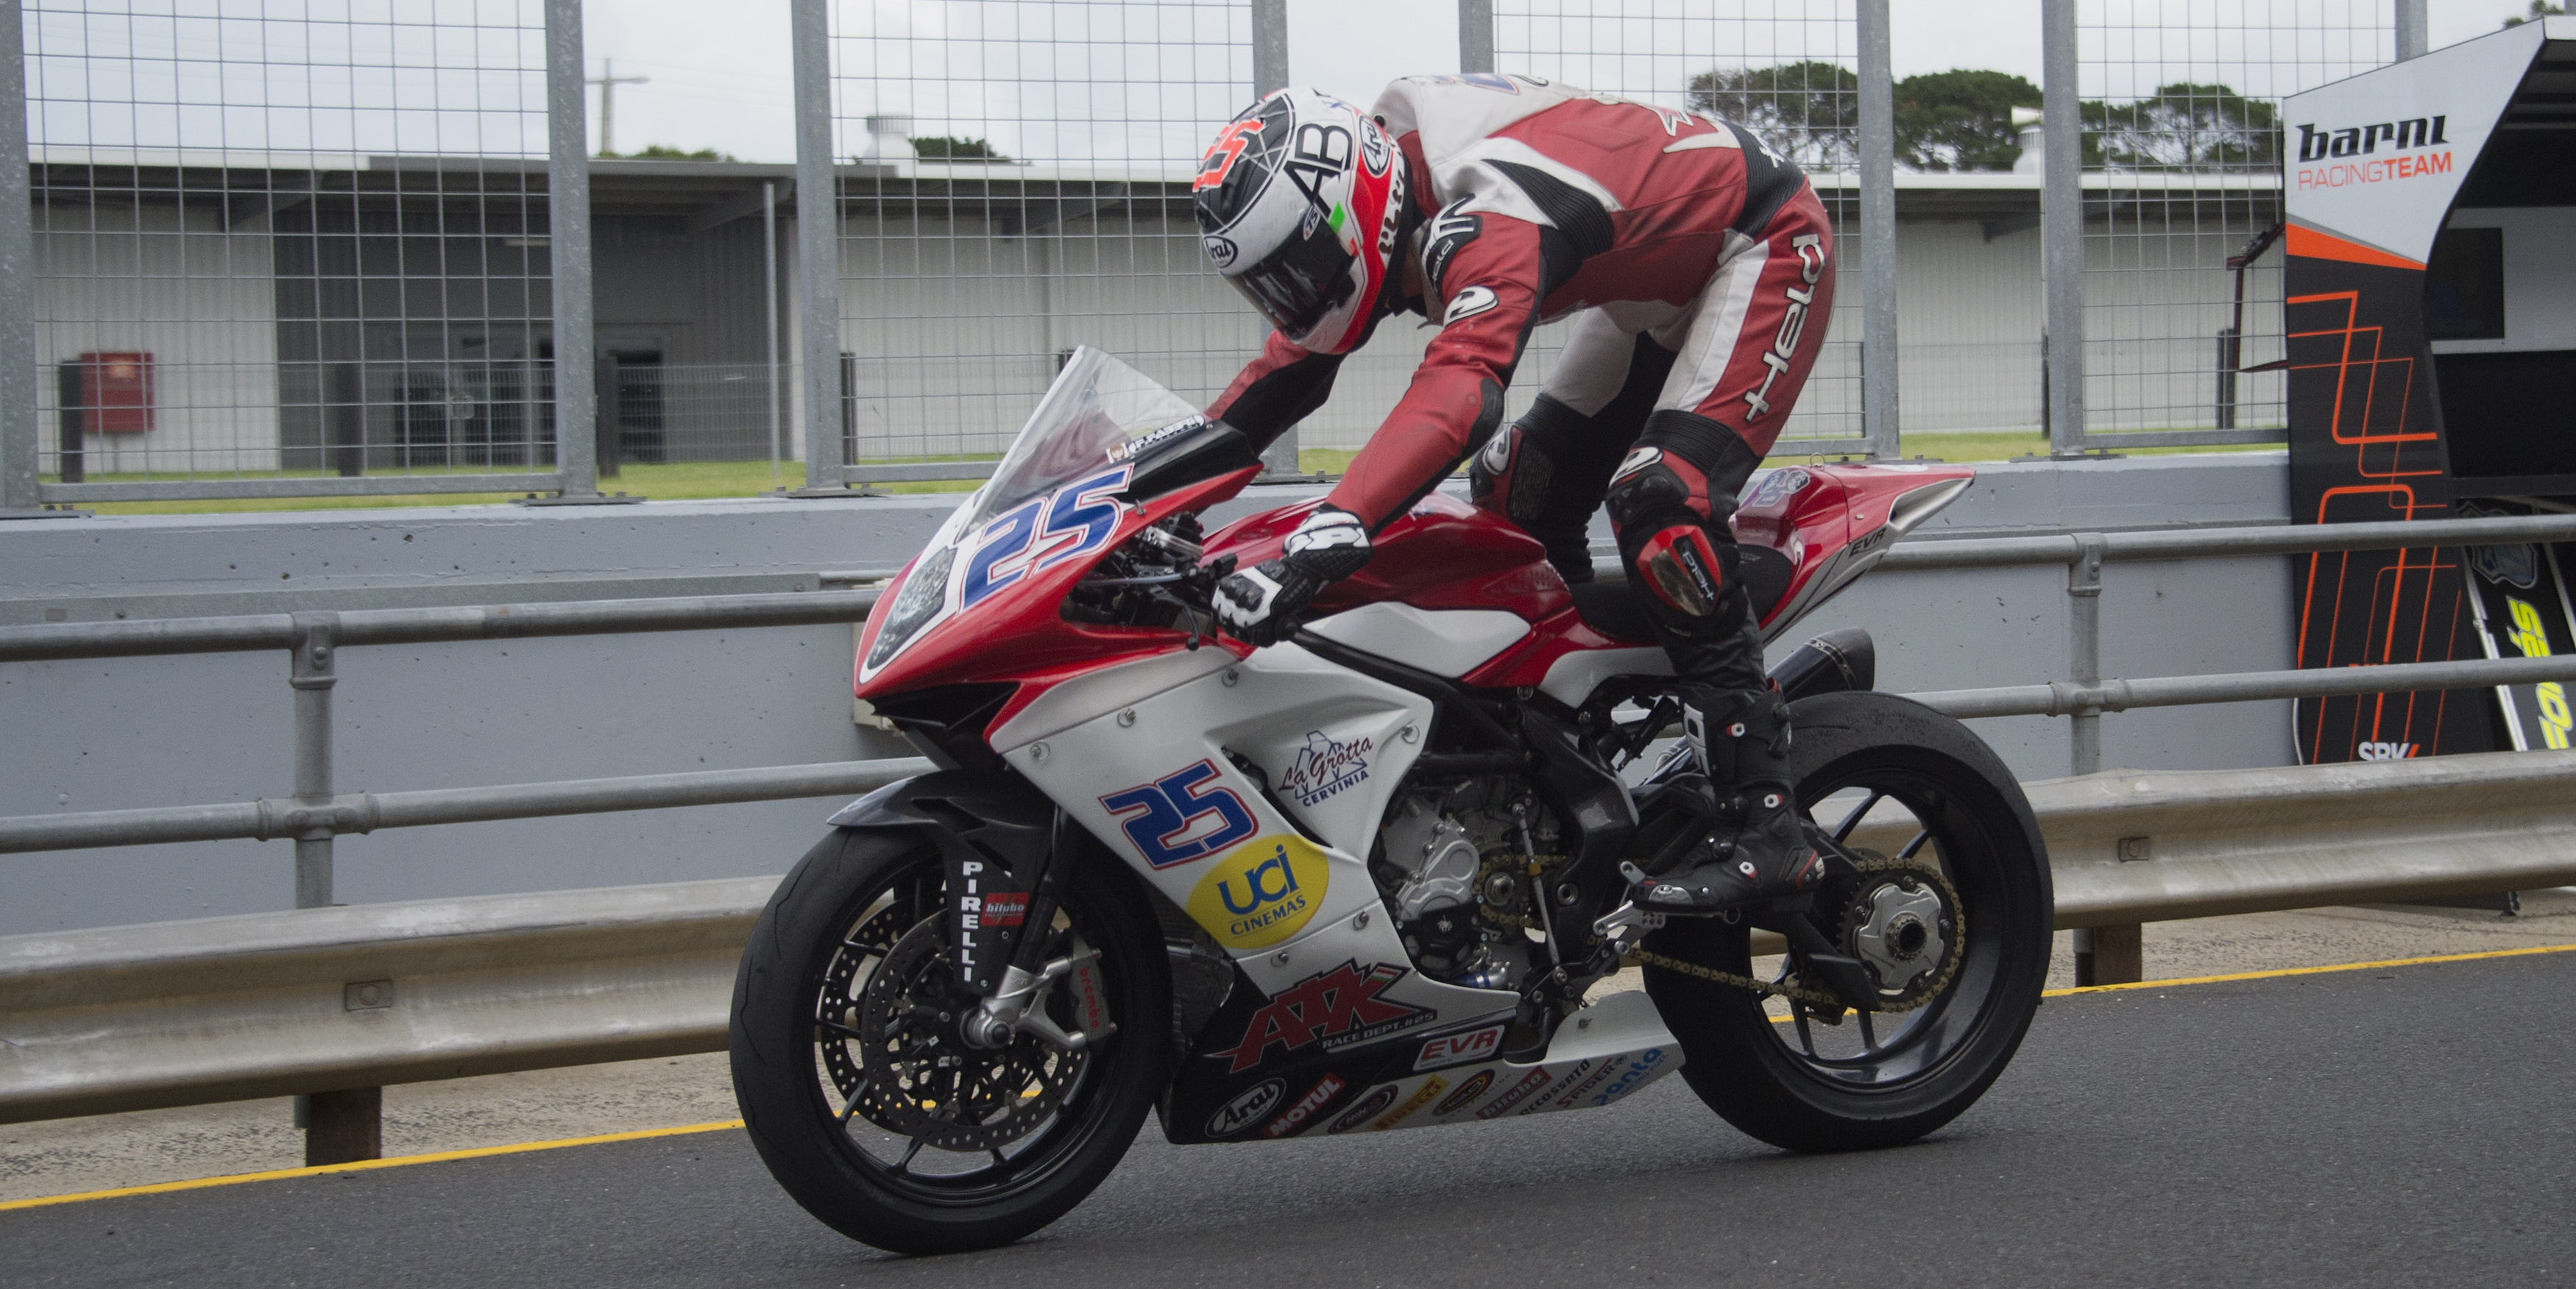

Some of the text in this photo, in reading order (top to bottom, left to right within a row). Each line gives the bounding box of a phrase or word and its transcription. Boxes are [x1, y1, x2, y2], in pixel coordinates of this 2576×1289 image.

[2296, 115, 2449, 163] barni
[958, 463, 1134, 614] 25
[1278, 736, 1374, 792] La Grotta
[1301, 770, 1370, 807] CERVINIA
[1098, 758, 1259, 870] 25
[960, 860, 983, 982] PIRELLI
[986, 901, 1025, 915] bitubo
[1230, 894, 1306, 936] CINEMAS
[1078, 965, 1100, 1030] brembo
[1323, 1035, 1361, 1049] RACE
[1420, 1029, 1498, 1061] EVR
[1217, 1080, 1277, 1132] Arai
[1269, 1078, 1342, 1136] MOTUL
